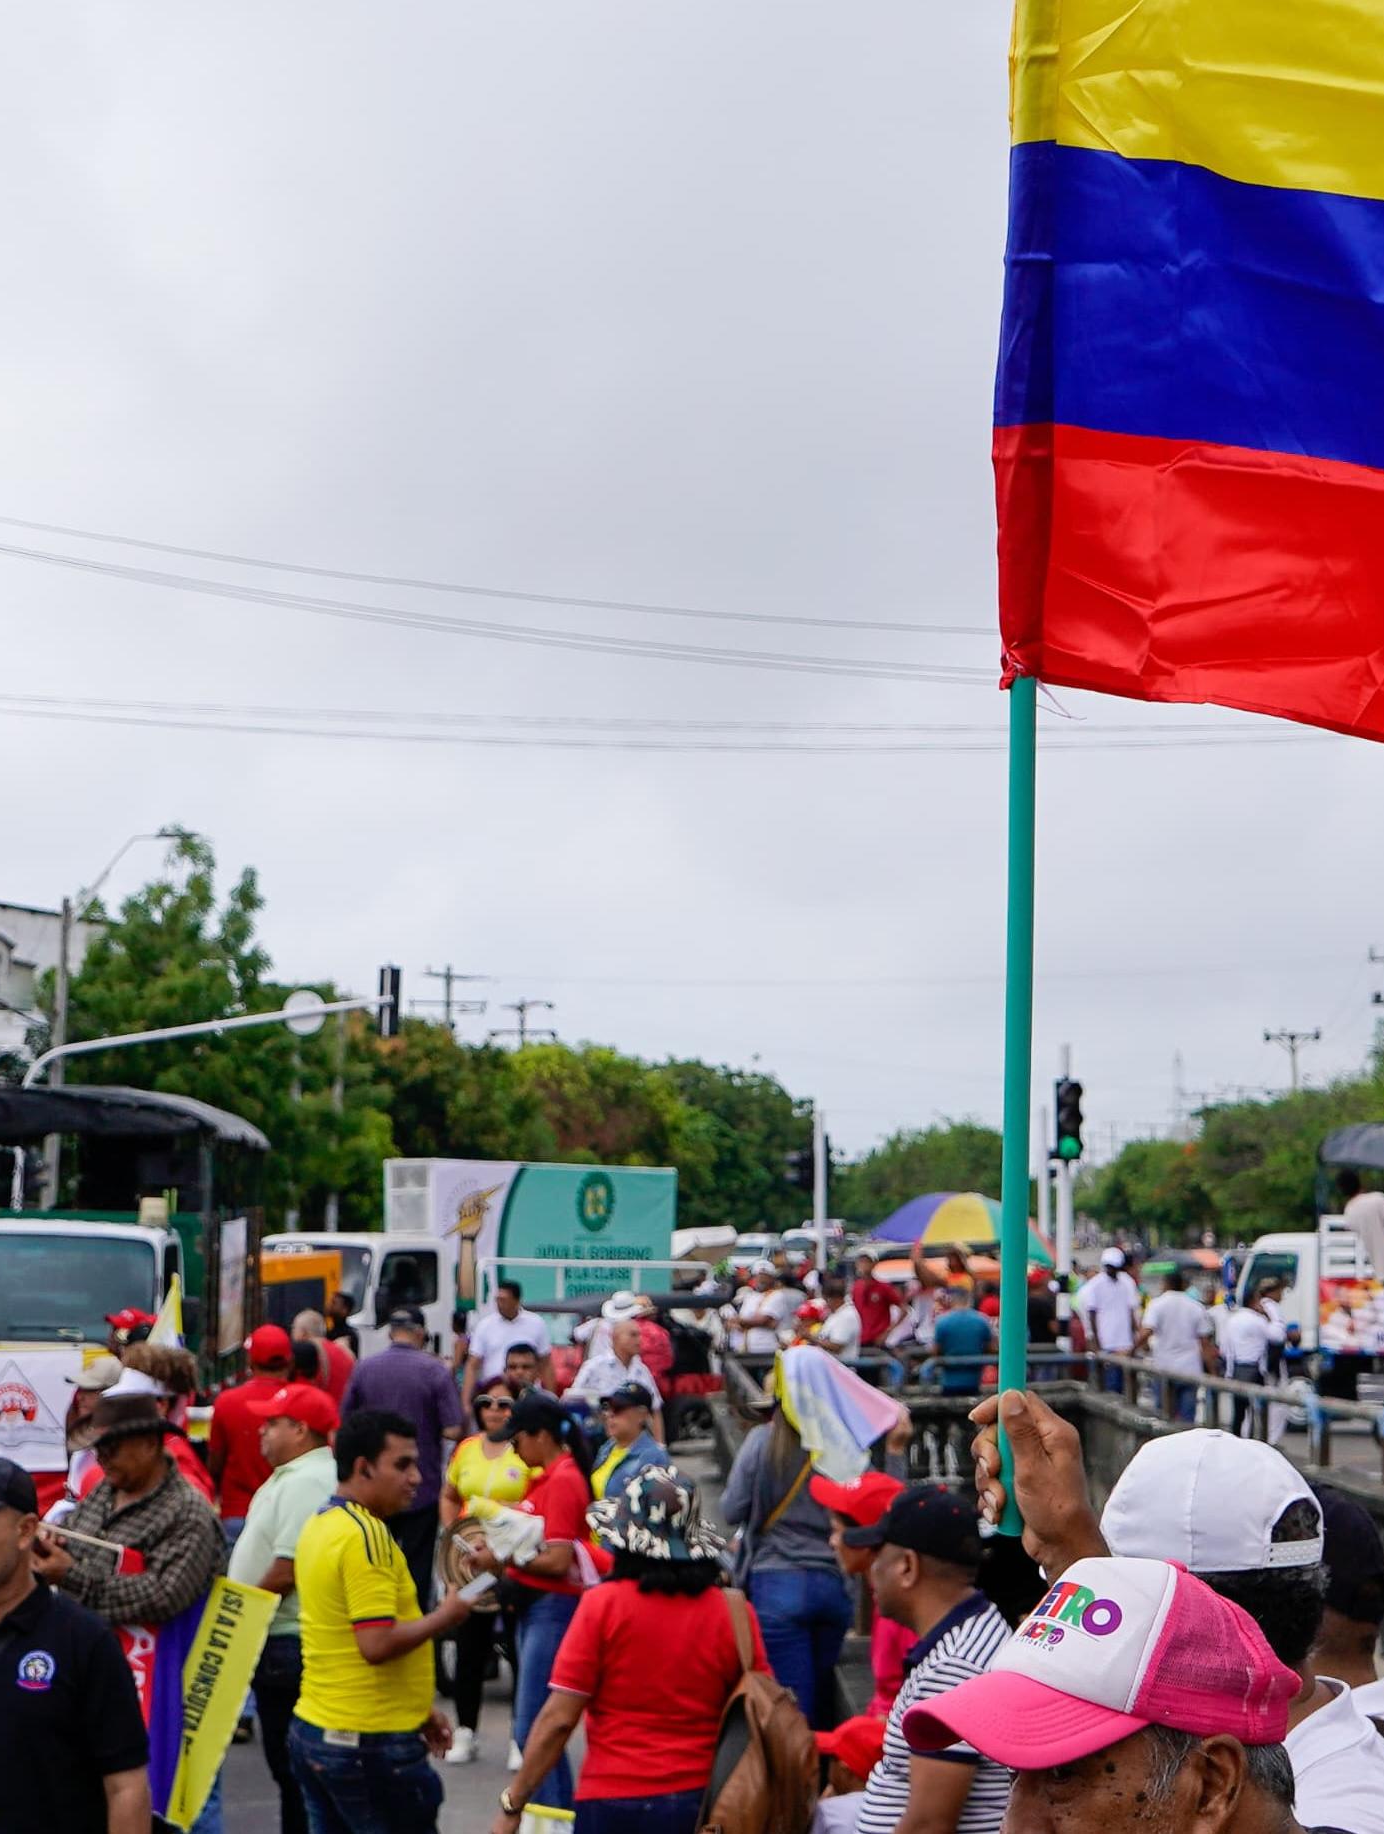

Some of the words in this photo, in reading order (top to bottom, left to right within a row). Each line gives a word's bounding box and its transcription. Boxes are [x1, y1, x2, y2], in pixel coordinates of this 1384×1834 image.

[1031, 1581, 1123, 1636] ETRO
[216, 1613, 236, 1628] A
[208, 1628, 233, 1650] LA
